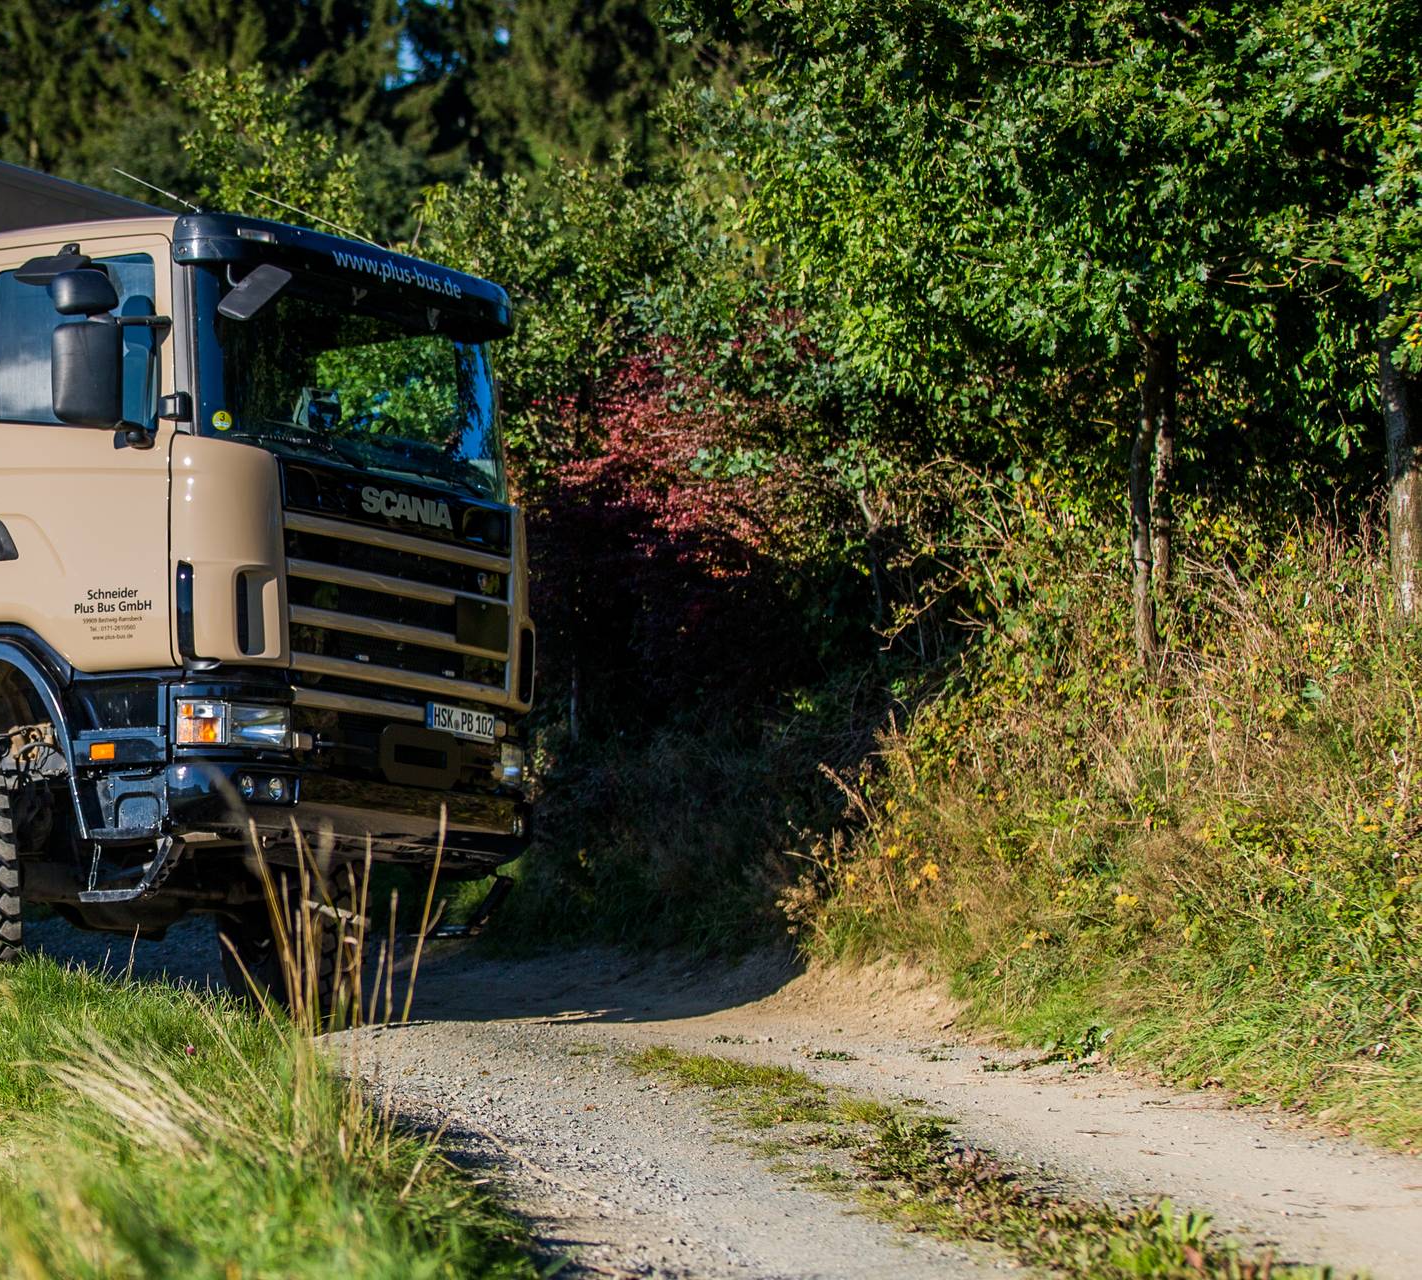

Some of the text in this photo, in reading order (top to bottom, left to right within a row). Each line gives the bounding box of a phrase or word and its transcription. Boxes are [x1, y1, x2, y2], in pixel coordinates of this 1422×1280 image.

[332, 250, 462, 299] www.plus-bus.de
[361, 486, 454, 530] SCANIA
[74, 600, 152, 614] Plus Bus GmbH
[87, 587, 138, 600] Schneider
[434, 706, 493, 737] HSK PB 102
